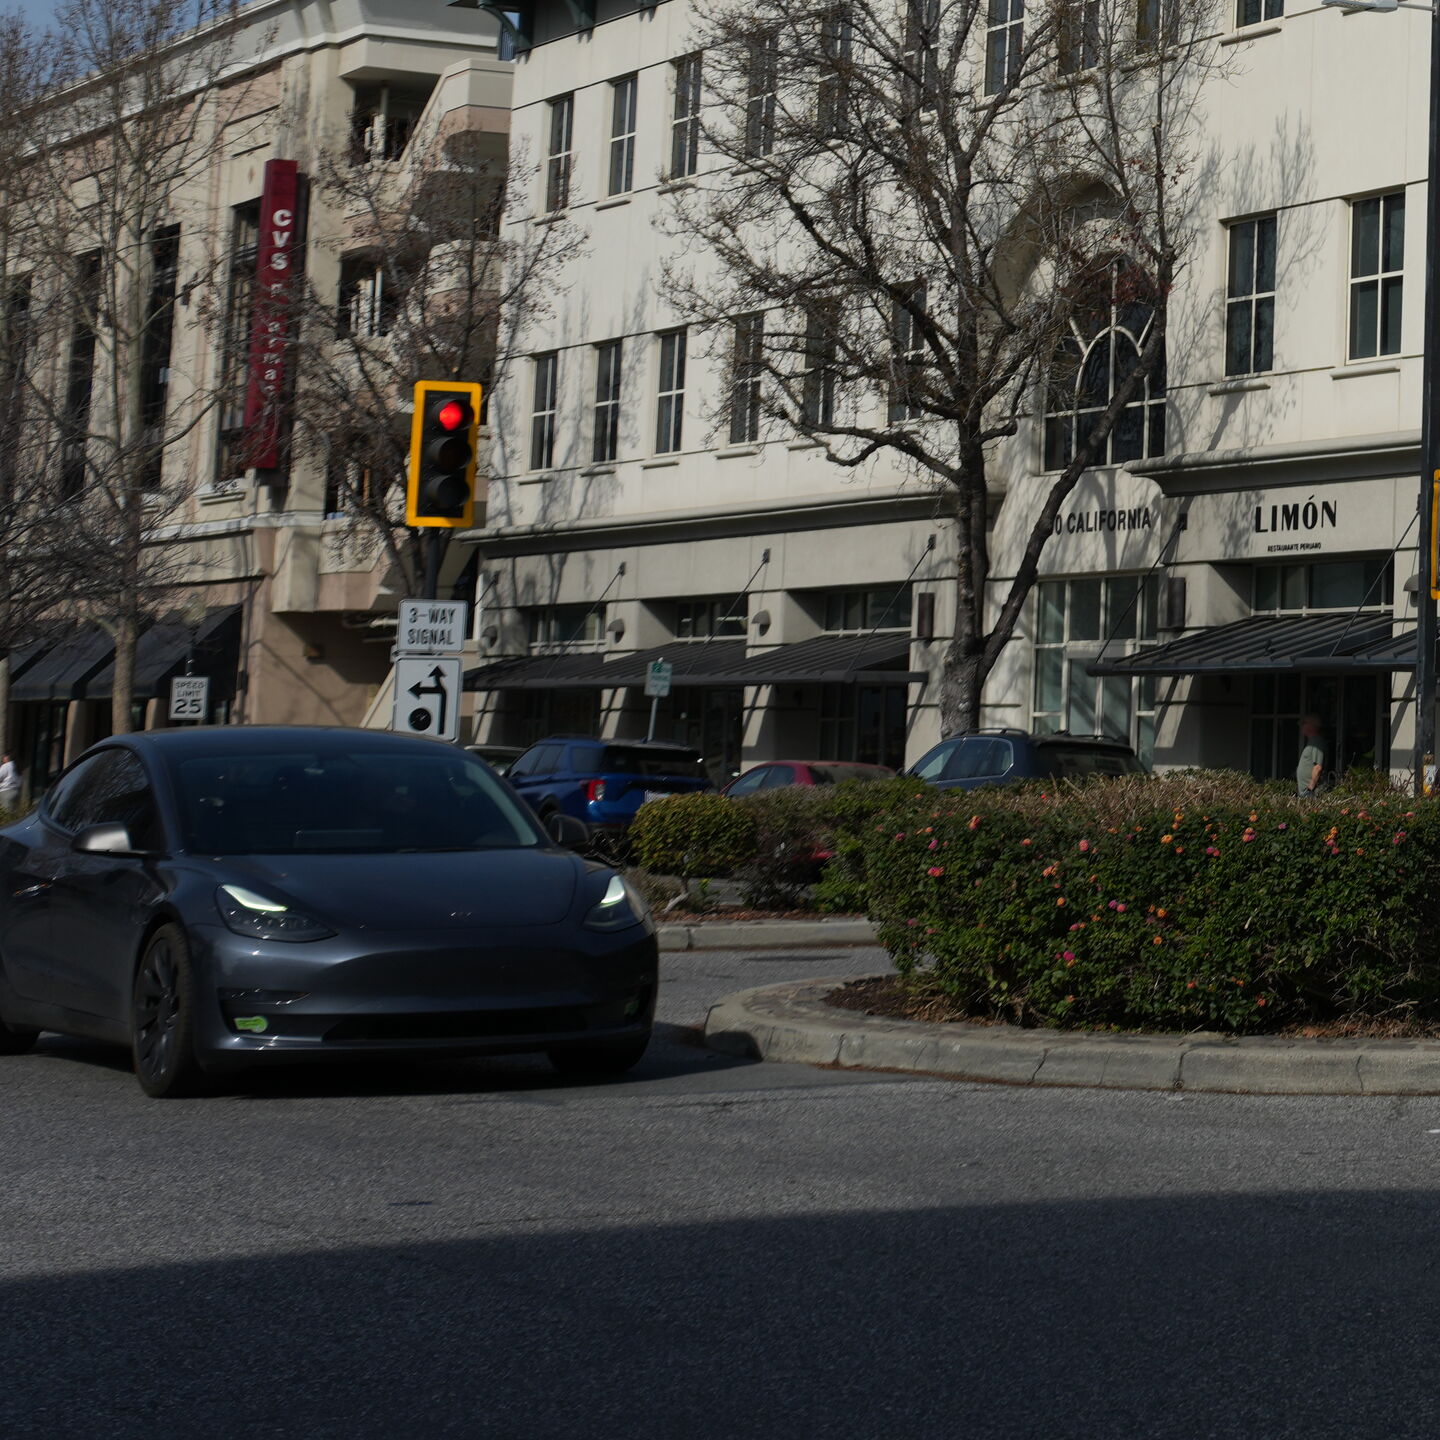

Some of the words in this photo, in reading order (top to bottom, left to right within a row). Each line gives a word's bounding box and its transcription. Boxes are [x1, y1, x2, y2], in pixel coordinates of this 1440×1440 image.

[270, 209, 292, 270] CVS
[1067, 507, 1151, 535] CALIFORNIA
[1255, 495, 1337, 533] LIMÓN
[1267, 543, 1299, 552] RESTAURANTE
[1300, 542, 1322, 551] PERUANO
[409, 607, 456, 624] 3-WAY
[407, 628, 455, 645] SIGNAL
[175, 681, 206, 689] SPEED
[174, 699, 202, 714] 25
